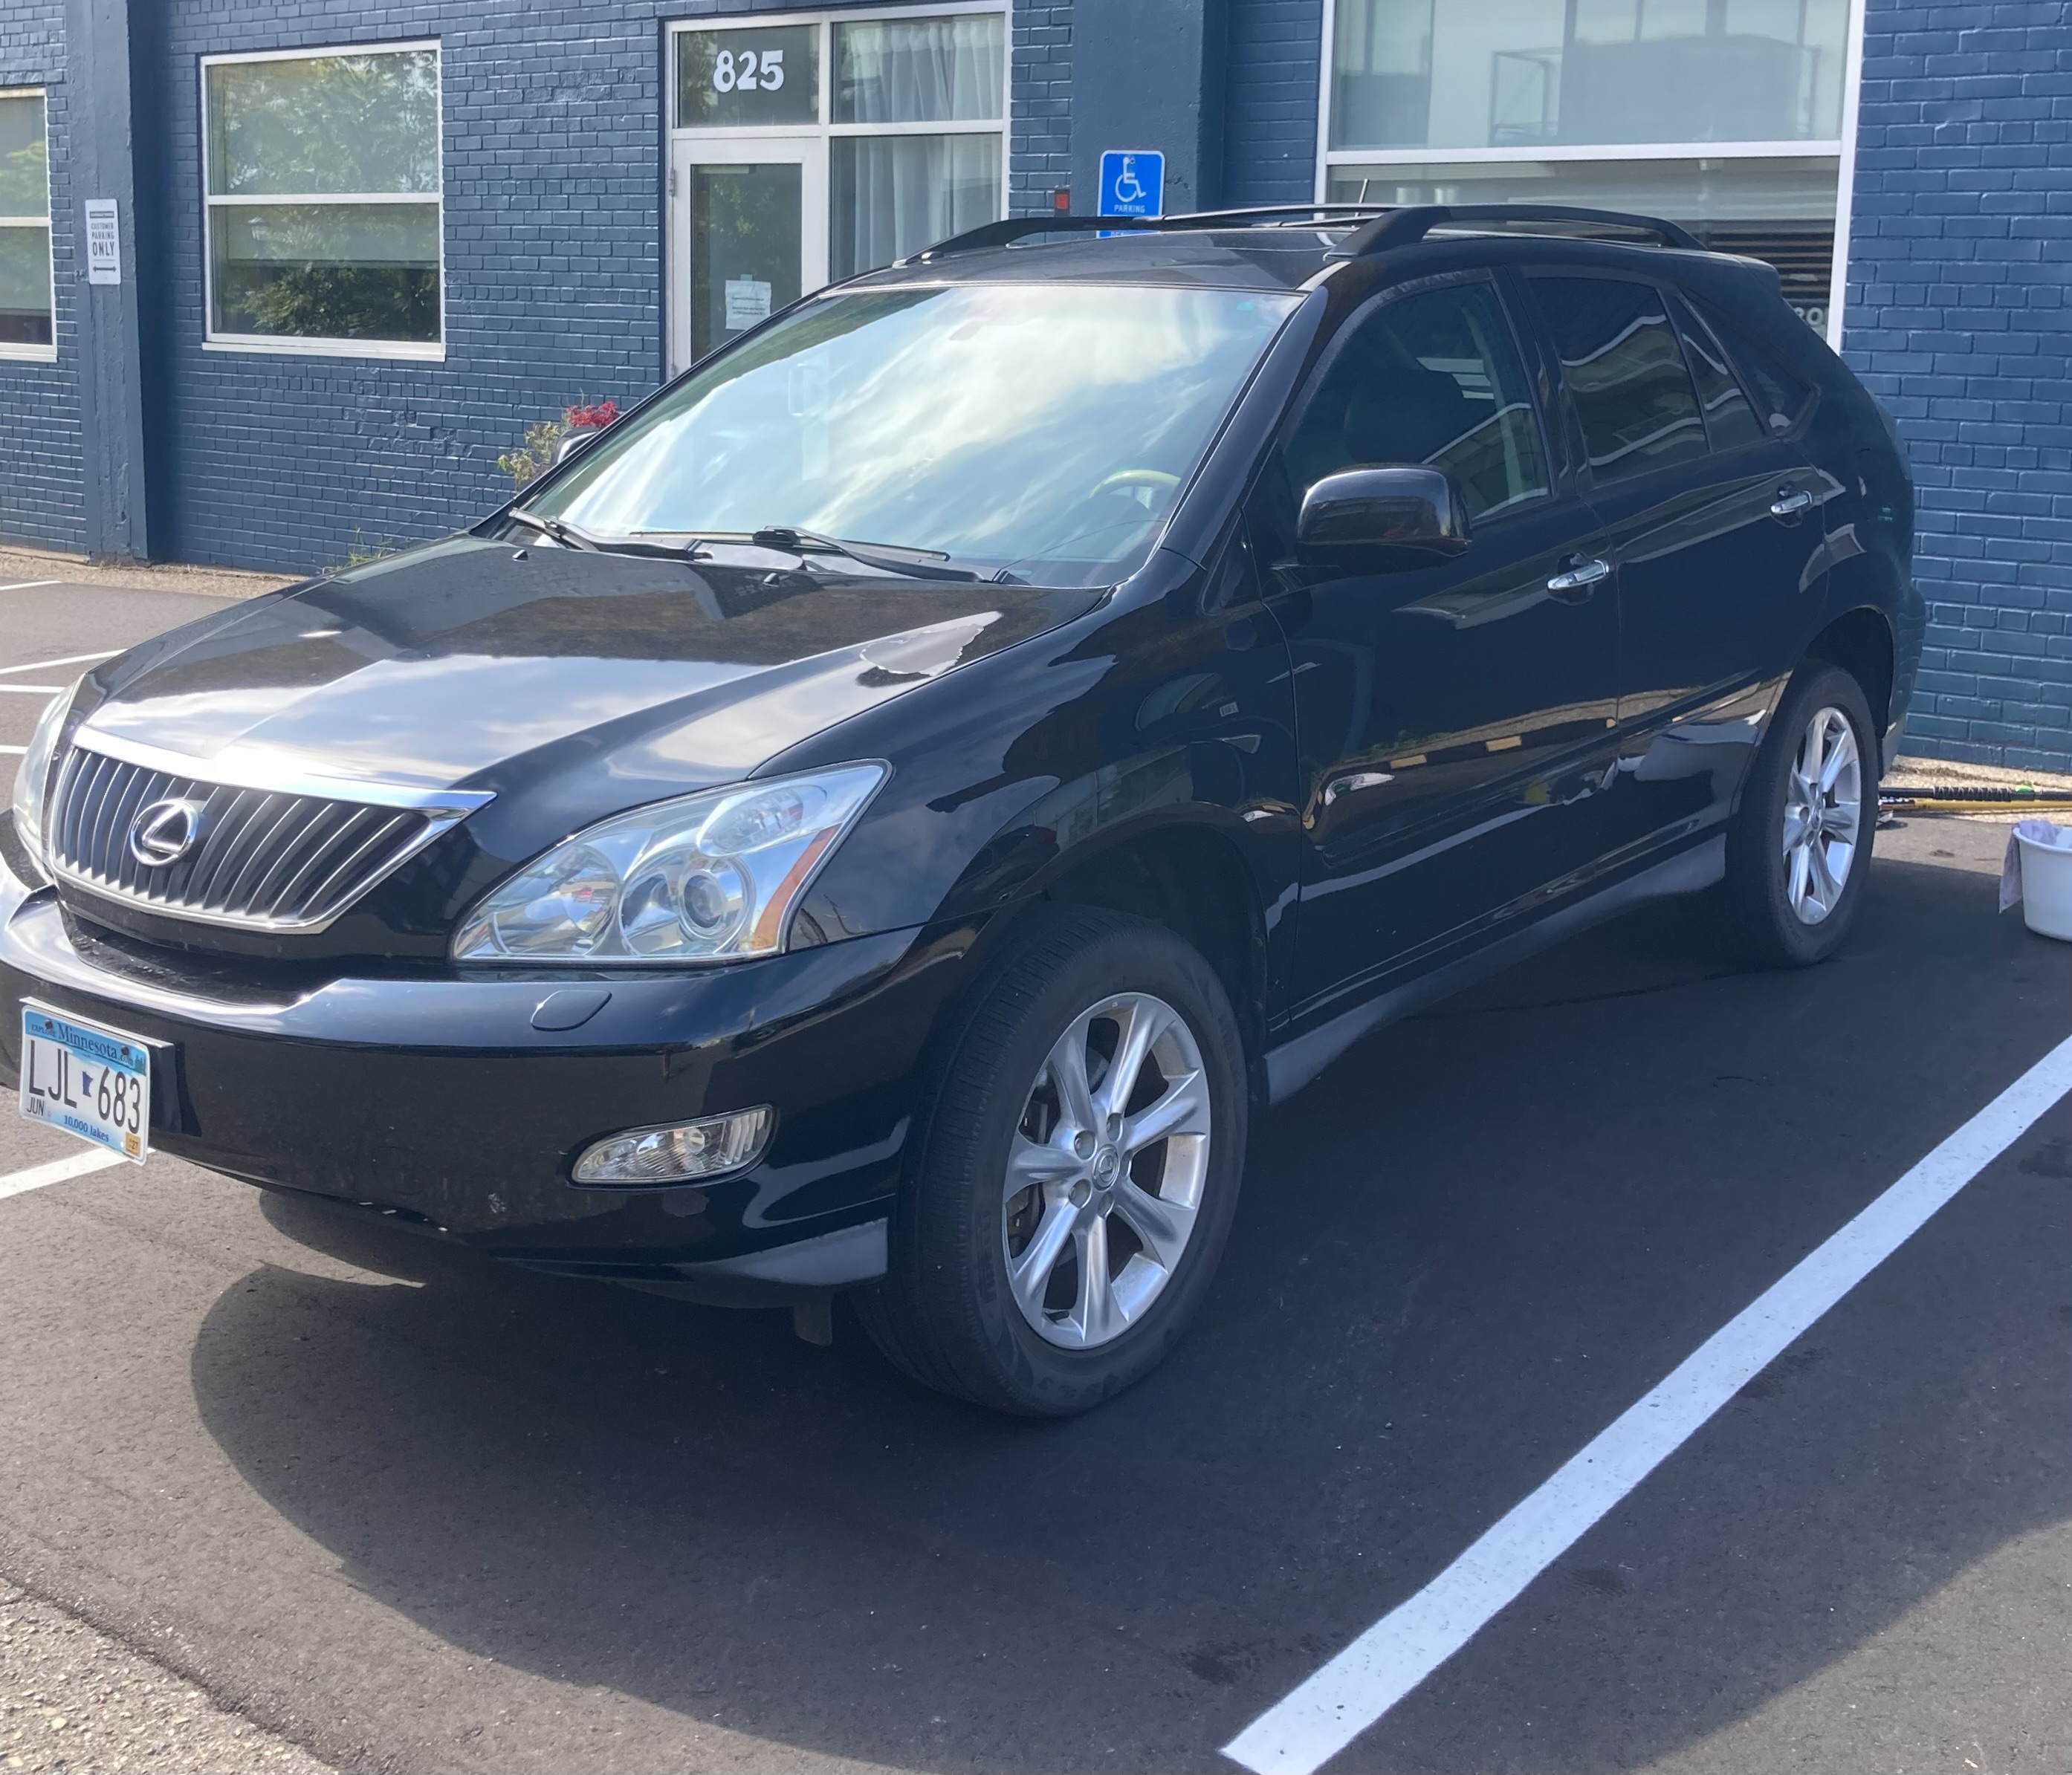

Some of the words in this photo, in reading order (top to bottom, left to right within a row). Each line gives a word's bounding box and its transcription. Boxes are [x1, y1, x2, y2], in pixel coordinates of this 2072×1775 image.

[713, 50, 784, 93] 825
[1114, 204, 1145, 213] PARKING
[91, 231, 114, 240] PARKING
[92, 241, 114, 256] ONLY
[29, 1040, 77, 1109] LJL
[98, 1066, 140, 1134] 683
[27, 1097, 45, 1117] JUN
[90, 1123, 110, 1143] lakes
